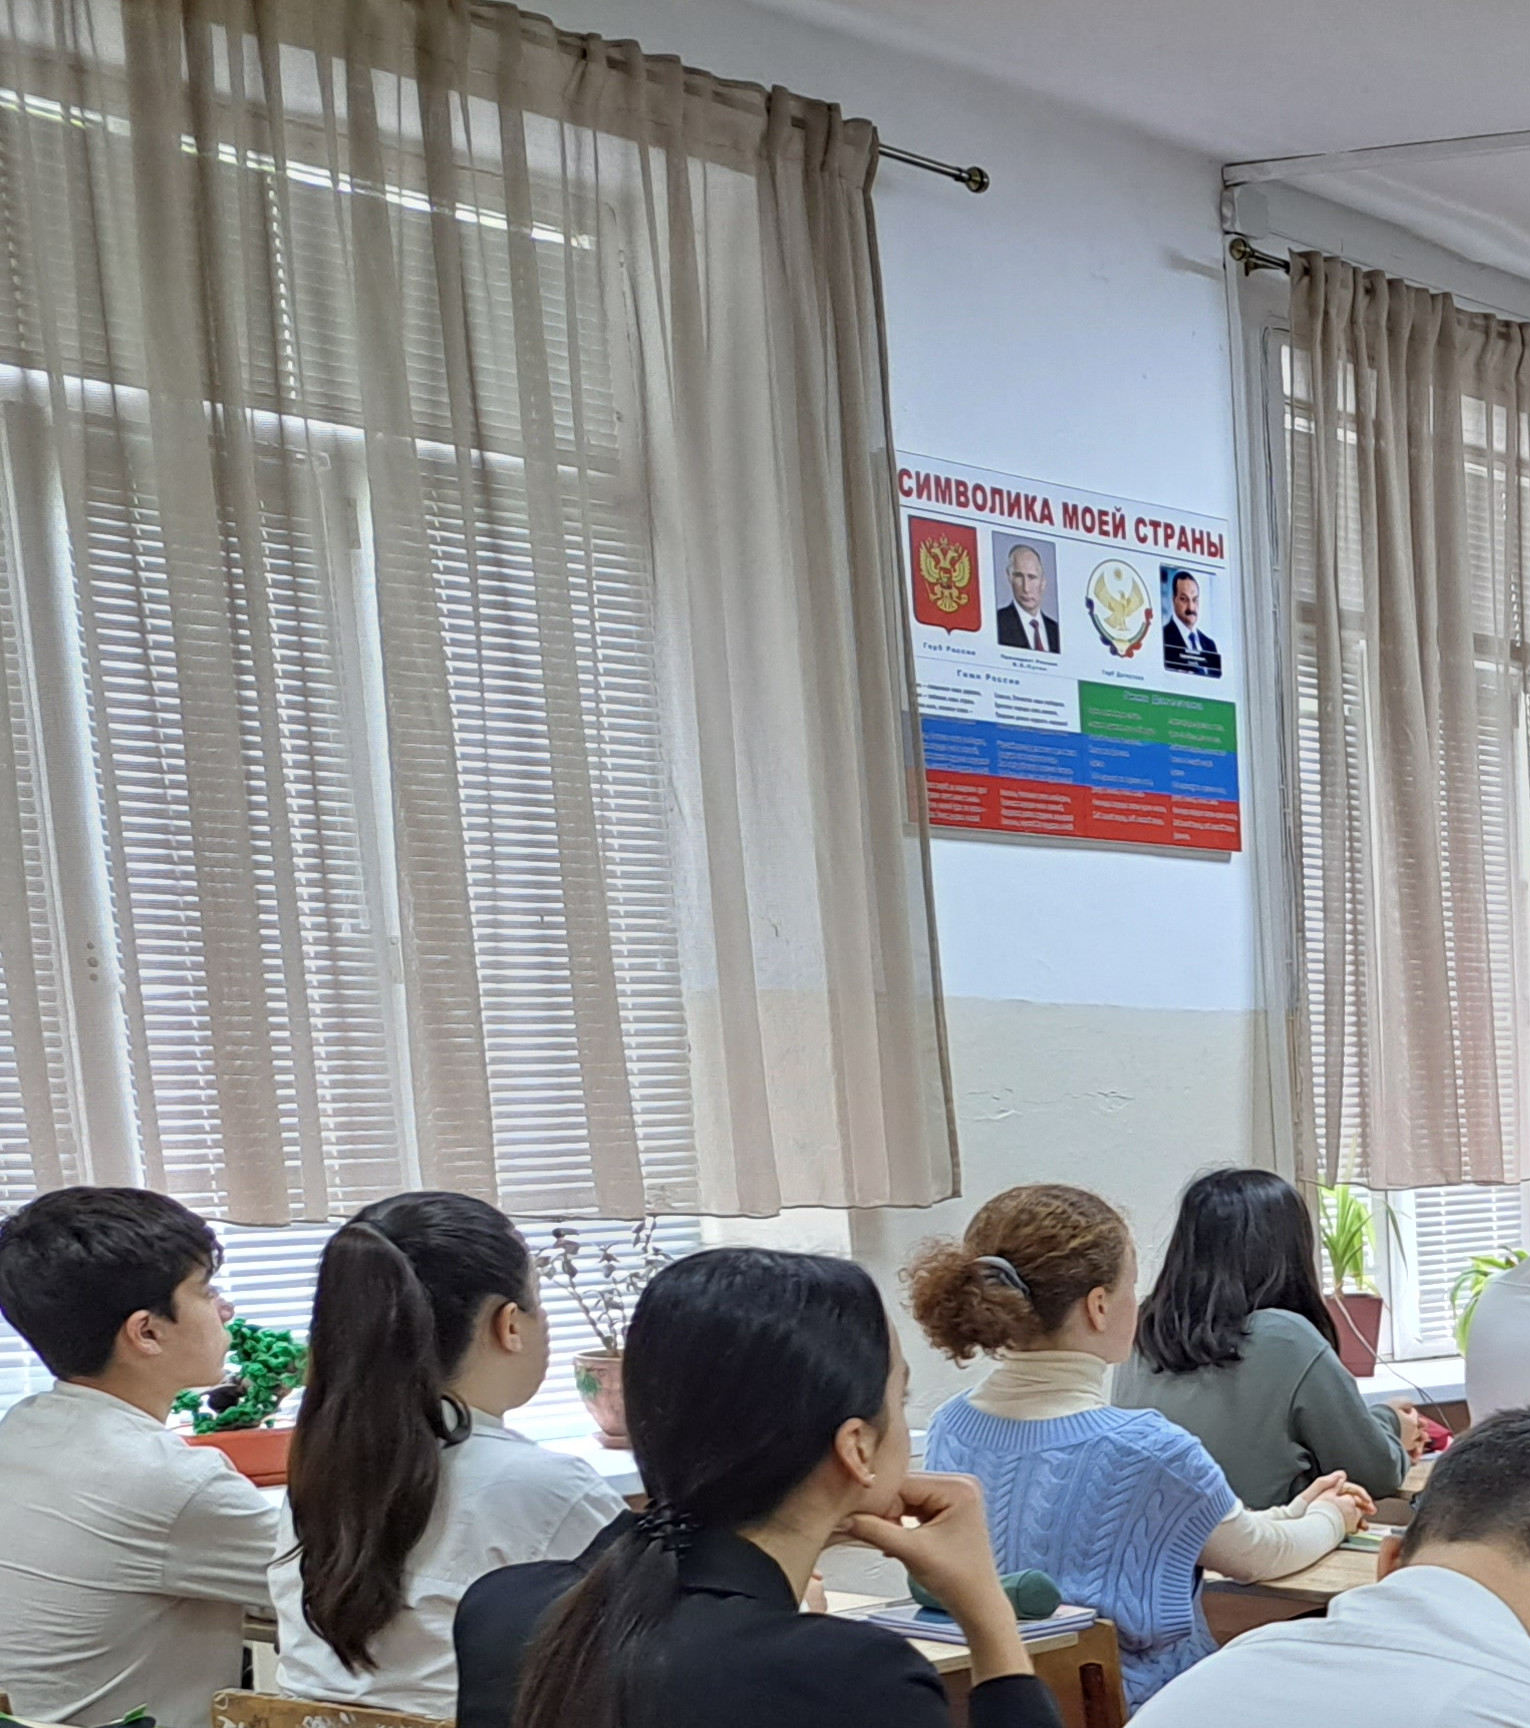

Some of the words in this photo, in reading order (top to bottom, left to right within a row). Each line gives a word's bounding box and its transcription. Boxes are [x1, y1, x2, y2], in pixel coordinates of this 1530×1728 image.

[898, 468, 1055, 527] СИМВОЛИКА
[1062, 501, 1127, 540] МОЕЙ
[1134, 517, 1225, 559] СТРАНЫ
